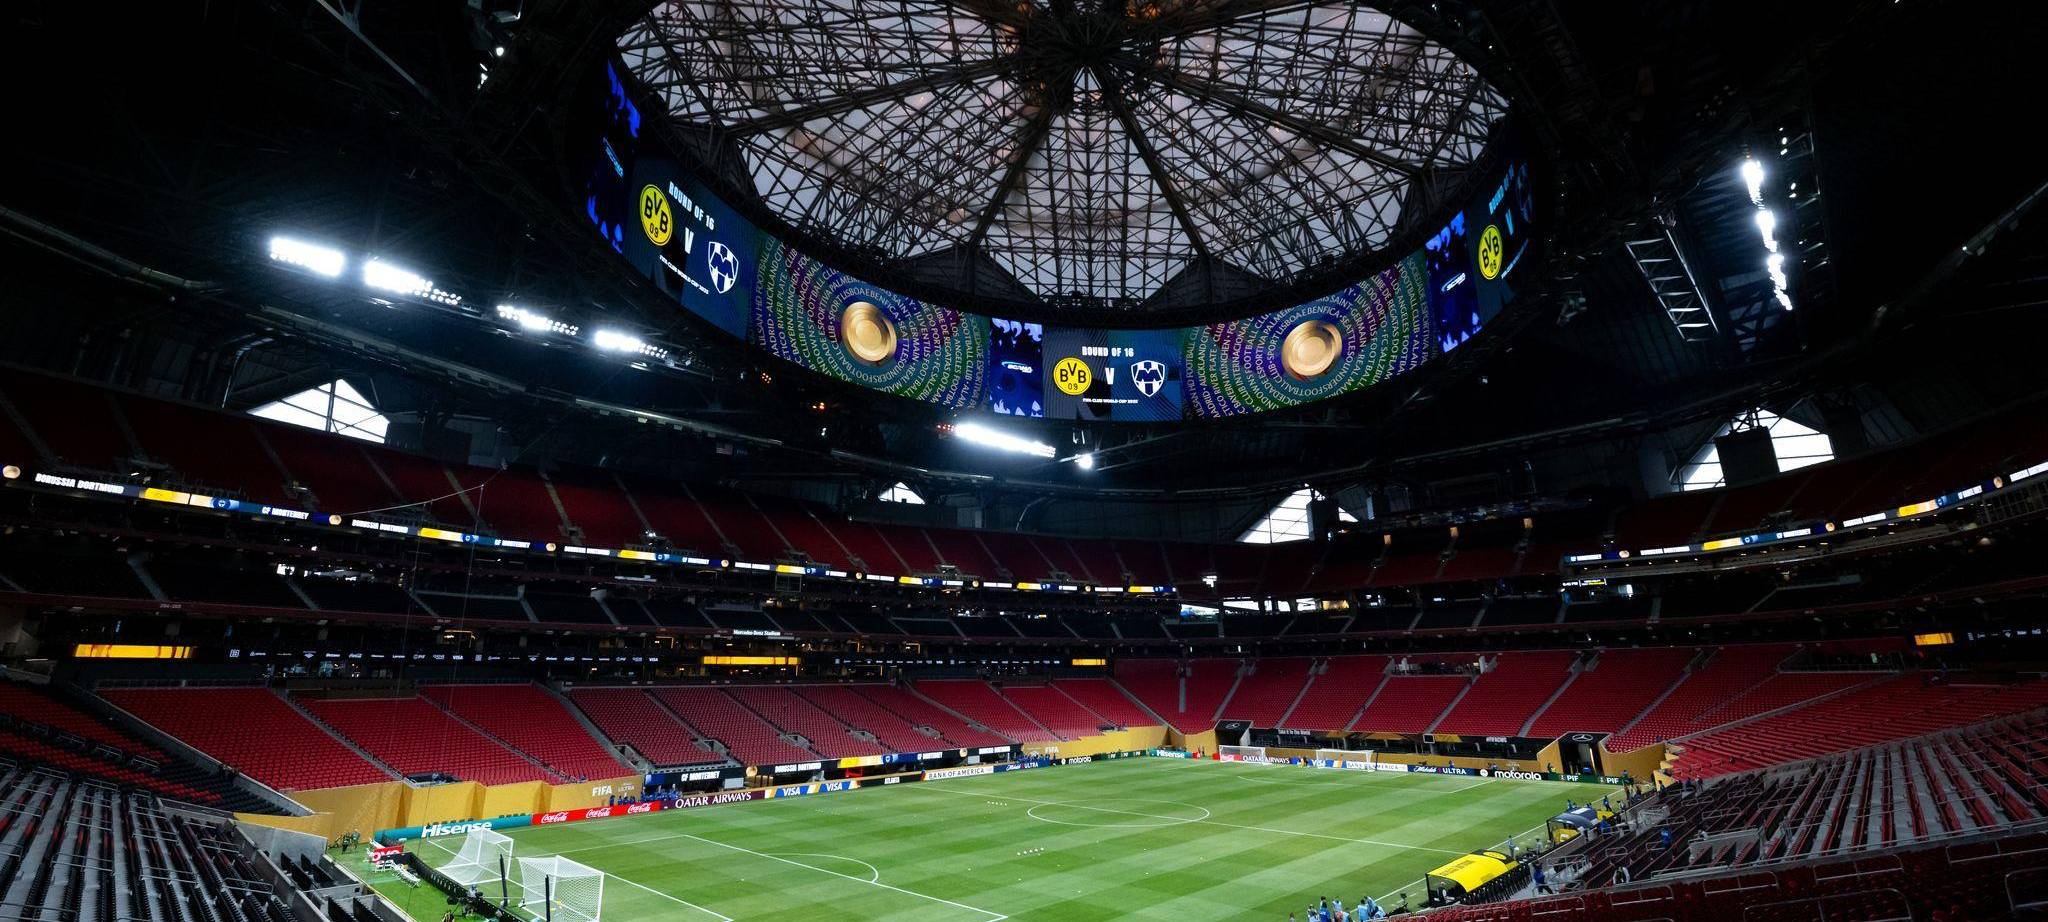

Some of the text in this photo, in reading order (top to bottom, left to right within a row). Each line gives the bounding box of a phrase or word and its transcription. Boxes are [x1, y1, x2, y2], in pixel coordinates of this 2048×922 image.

[668, 181, 715, 231] ROUND OF 16
[644, 192, 668, 233] BVB
[649, 222, 659, 238] 09
[684, 227, 695, 255] V
[1481, 232, 1500, 268] BVB
[1081, 346, 1135, 357] ROUND OF 16
[1059, 362, 1087, 384] BVB
[1105, 367, 1115, 385] V
[1067, 382, 1079, 391] 09
[35, 473, 125, 495] BORUSSIA DORTMUND
[261, 506, 310, 520] CF MONTERREY
[1156, 749, 1185, 758] Hisense
[1265, 756, 1290, 764] AIRWAYS
[680, 771, 721, 782] CF MONTERREY
[928, 767, 985, 780] BANK OF AMERICA
[1494, 770, 1542, 781] motorola
[1566, 774, 1580, 782] PIF
[825, 782, 844, 792] VISA
[1606, 777, 1620, 785] PIF
[591, 785, 613, 797] FIFA
[782, 786, 801, 796] VISA
[675, 791, 752, 809] QATAR AIRWAYS
[585, 807, 613, 819] Coca-Cola
[627, 802, 653, 814] Coca-Cola
[541, 812, 569, 824] Coca-Cola
[421, 821, 493, 838] Hisense
